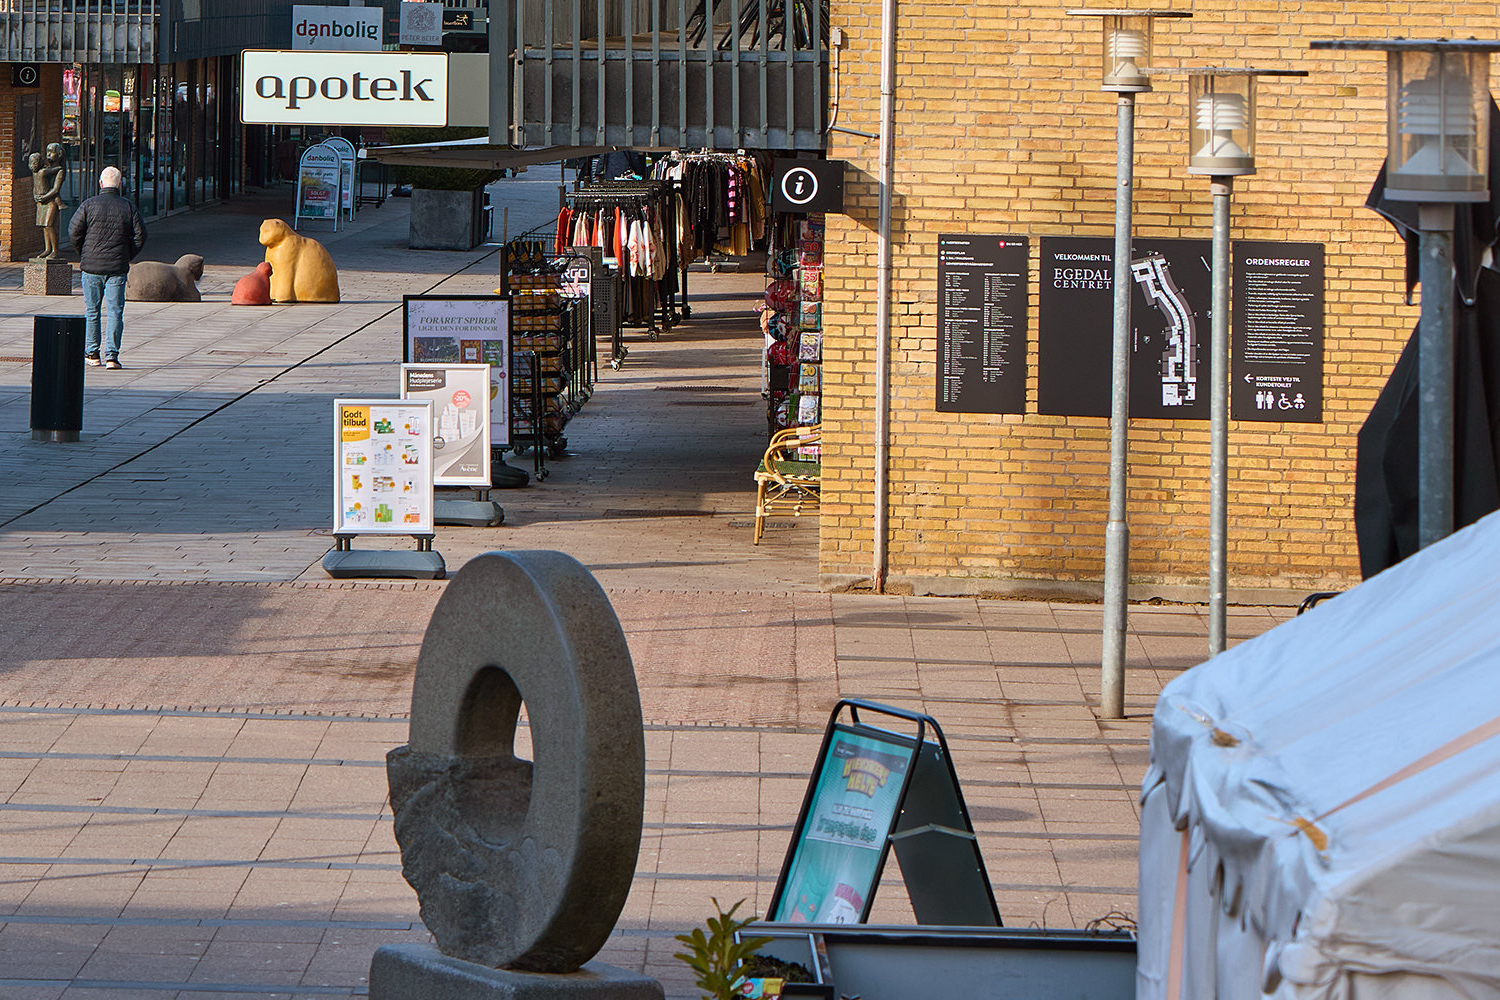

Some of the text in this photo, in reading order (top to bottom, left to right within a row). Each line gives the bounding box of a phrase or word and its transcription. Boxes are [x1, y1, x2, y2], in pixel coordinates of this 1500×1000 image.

[296, 20, 378, 40] danbolig
[255, 70, 435, 109] apotek
[1054, 254, 1112, 262] VELKOMMEN TIL
[1245, 258, 1311, 267] ORDENSREGLER
[803, 272, 817, 280] 55
[1054, 268, 1112, 280] EGEDAL
[1053, 280, 1112, 289] CENTRET
[464, 316, 497, 324] SPIRER
[343, 410, 362, 418] Godt
[343, 418, 366, 426] tilbud
